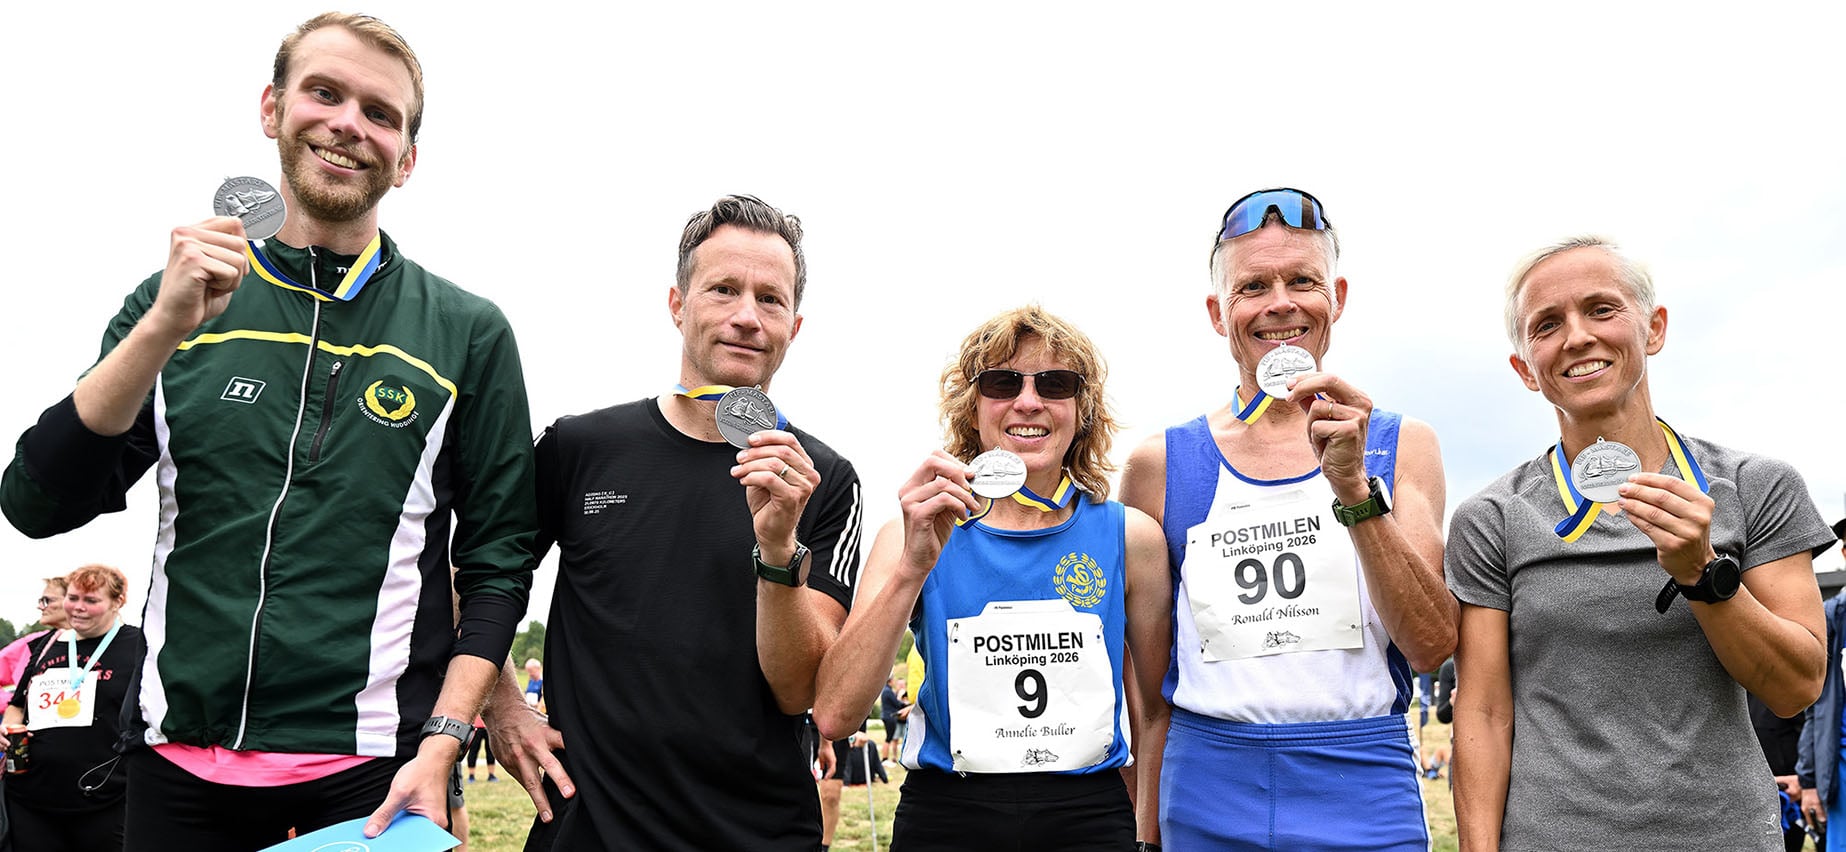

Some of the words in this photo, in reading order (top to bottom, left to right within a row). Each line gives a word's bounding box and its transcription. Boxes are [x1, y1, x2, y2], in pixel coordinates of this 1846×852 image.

[378, 387, 405, 403] SSK
[357, 397, 389, 426] ORIENTERING
[1211, 515, 1321, 547] POSTMILEN
[1222, 542, 1283, 558] Linköping
[1287, 534, 1317, 548] 2026
[1234, 552, 1306, 605] 90
[1231, 606, 1273, 625] Ronald
[1275, 604, 1320, 619] Nilsson
[973, 632, 1084, 653] POSTMILEN
[985, 653, 1047, 667] Linköping
[1050, 651, 1079, 664] 2026
[1014, 669, 1048, 719] 9
[995, 724, 1038, 739] Annelie
[1039, 722, 1076, 737] Buller
